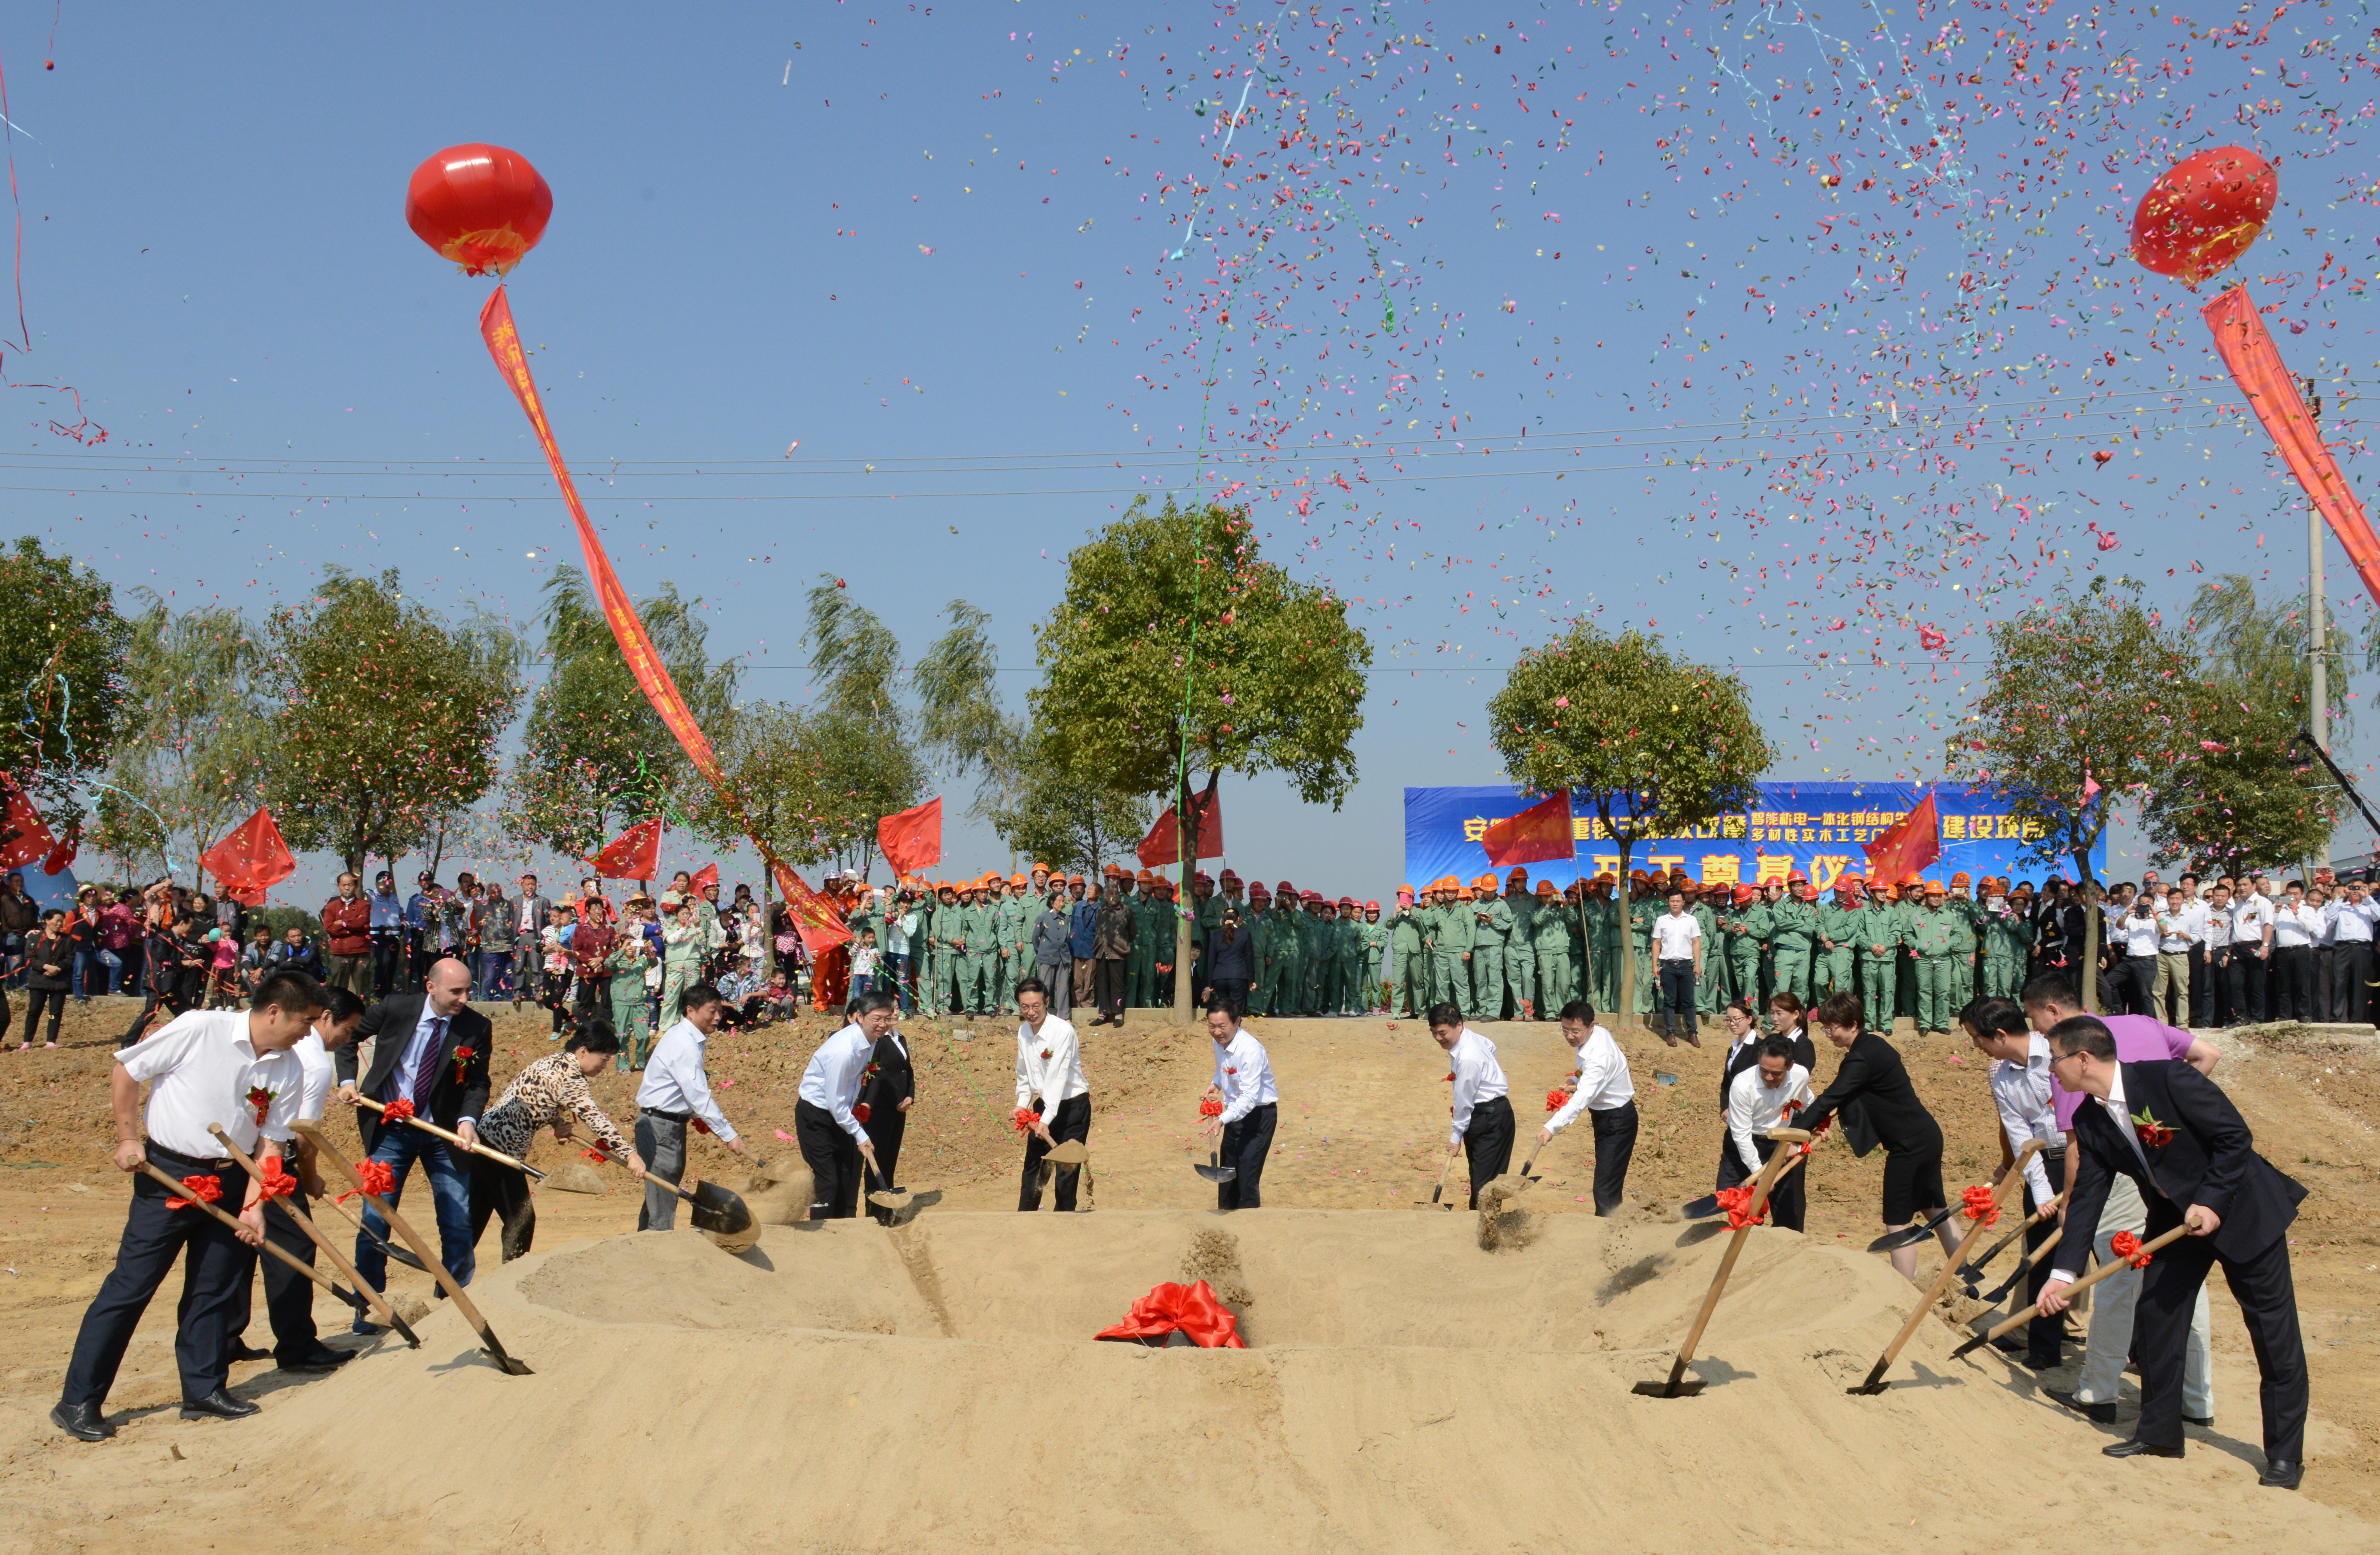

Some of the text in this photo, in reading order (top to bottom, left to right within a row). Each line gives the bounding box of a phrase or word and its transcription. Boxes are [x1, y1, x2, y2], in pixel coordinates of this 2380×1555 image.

[1593, 854, 1875, 892] 开工奠基仪
